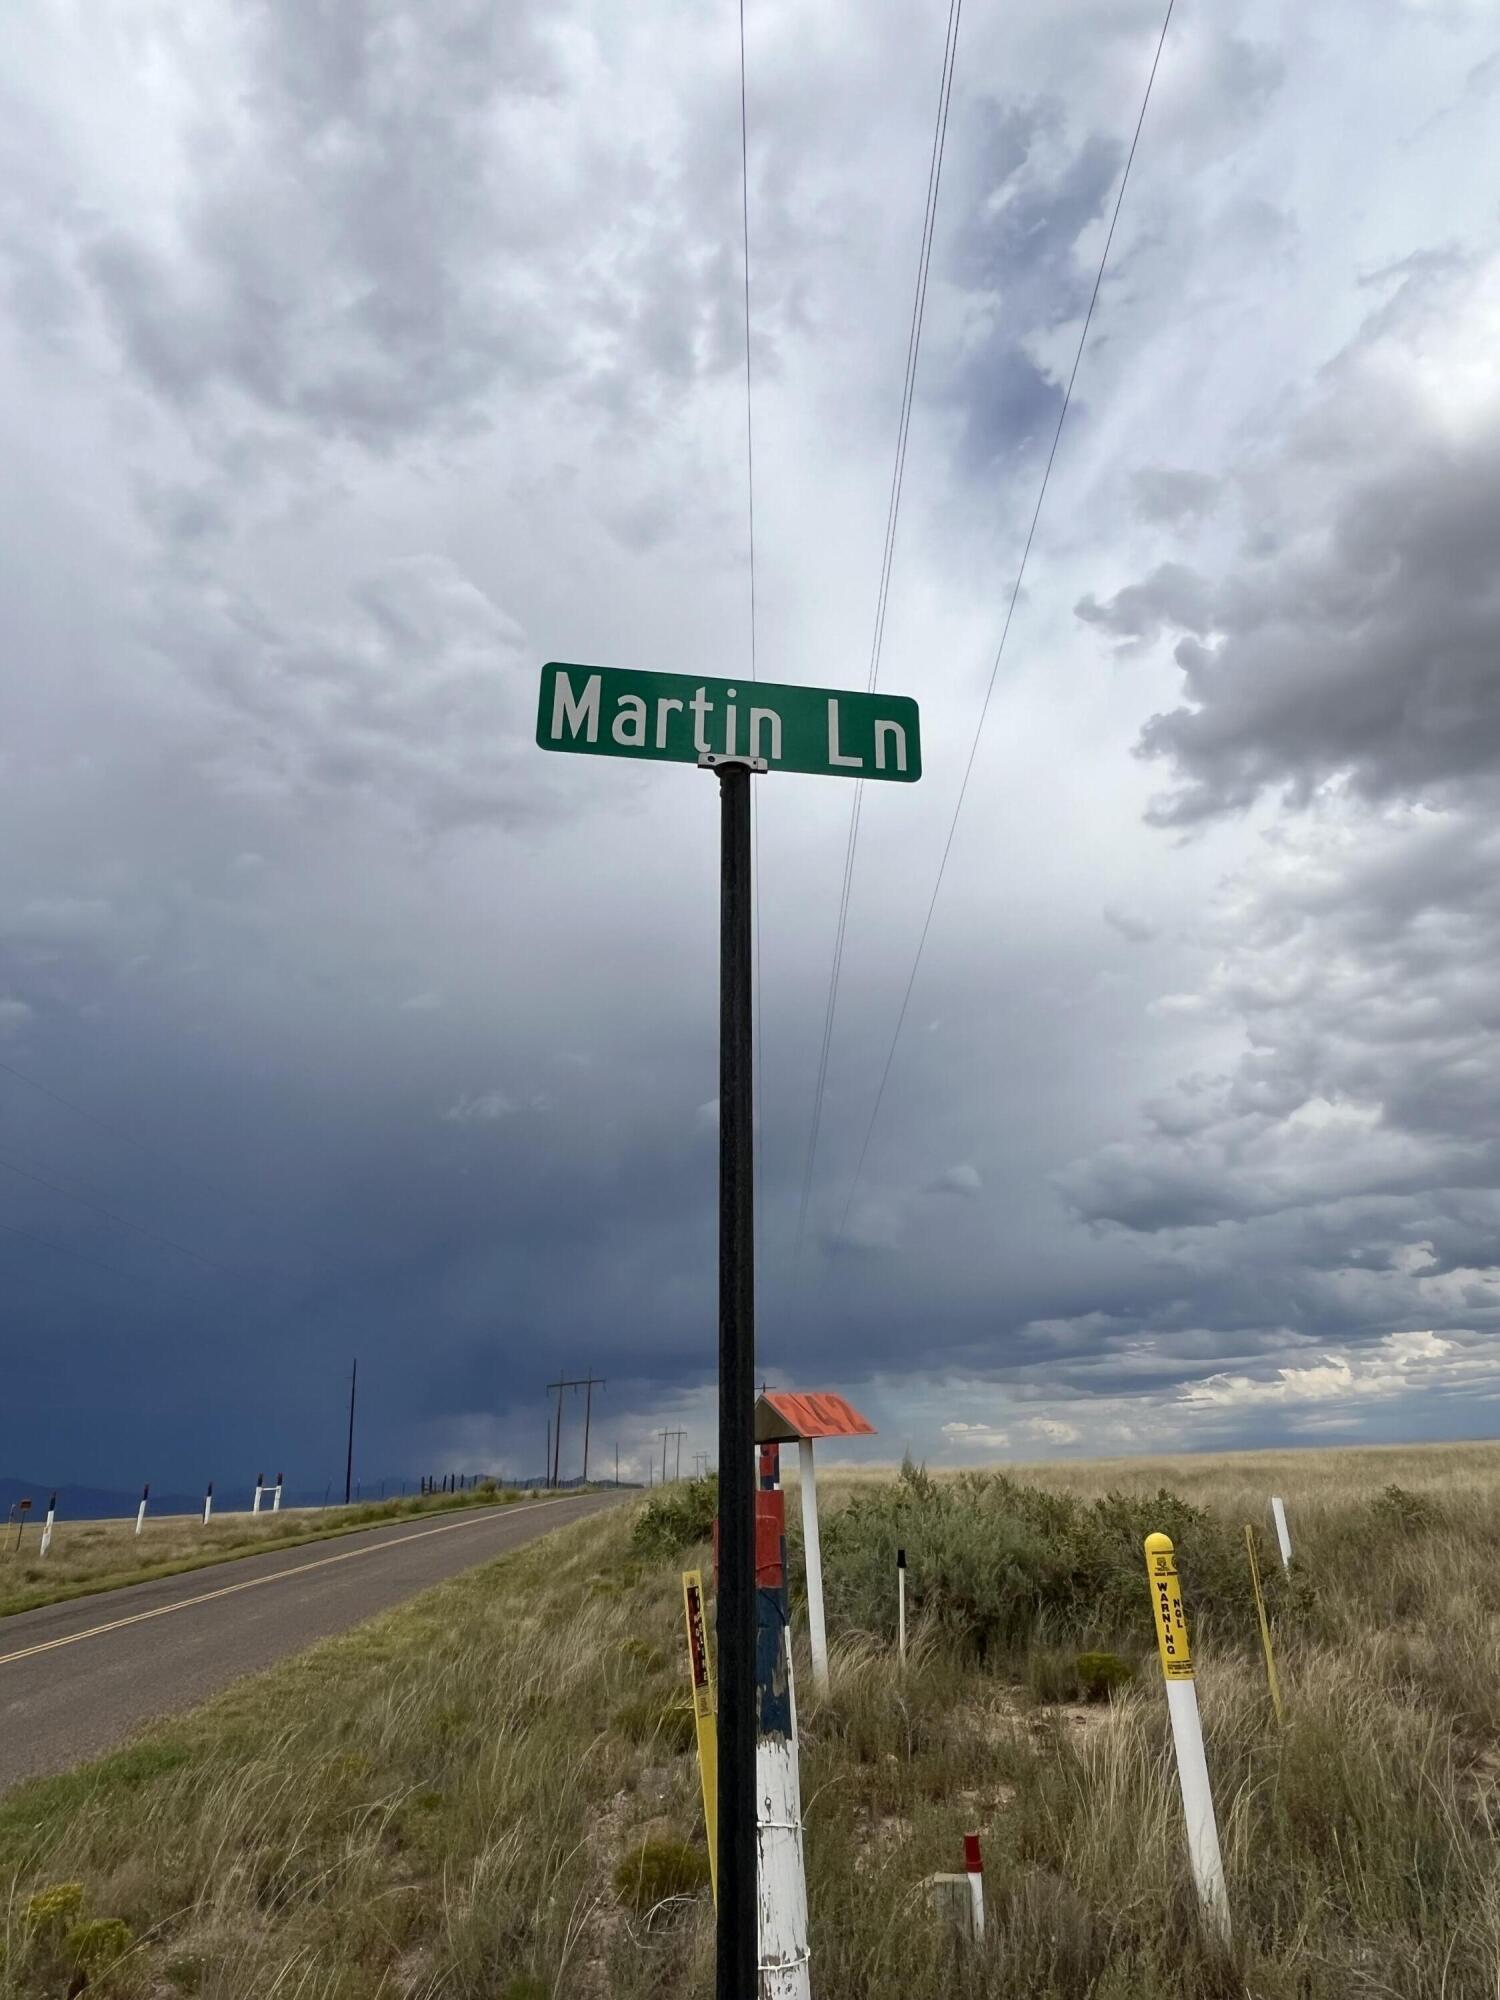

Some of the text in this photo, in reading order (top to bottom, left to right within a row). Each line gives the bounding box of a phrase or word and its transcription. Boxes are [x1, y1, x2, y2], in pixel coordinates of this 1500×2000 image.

[550, 671, 907, 771] Martin Ln
[1156, 1582, 1176, 1655] WARNING
